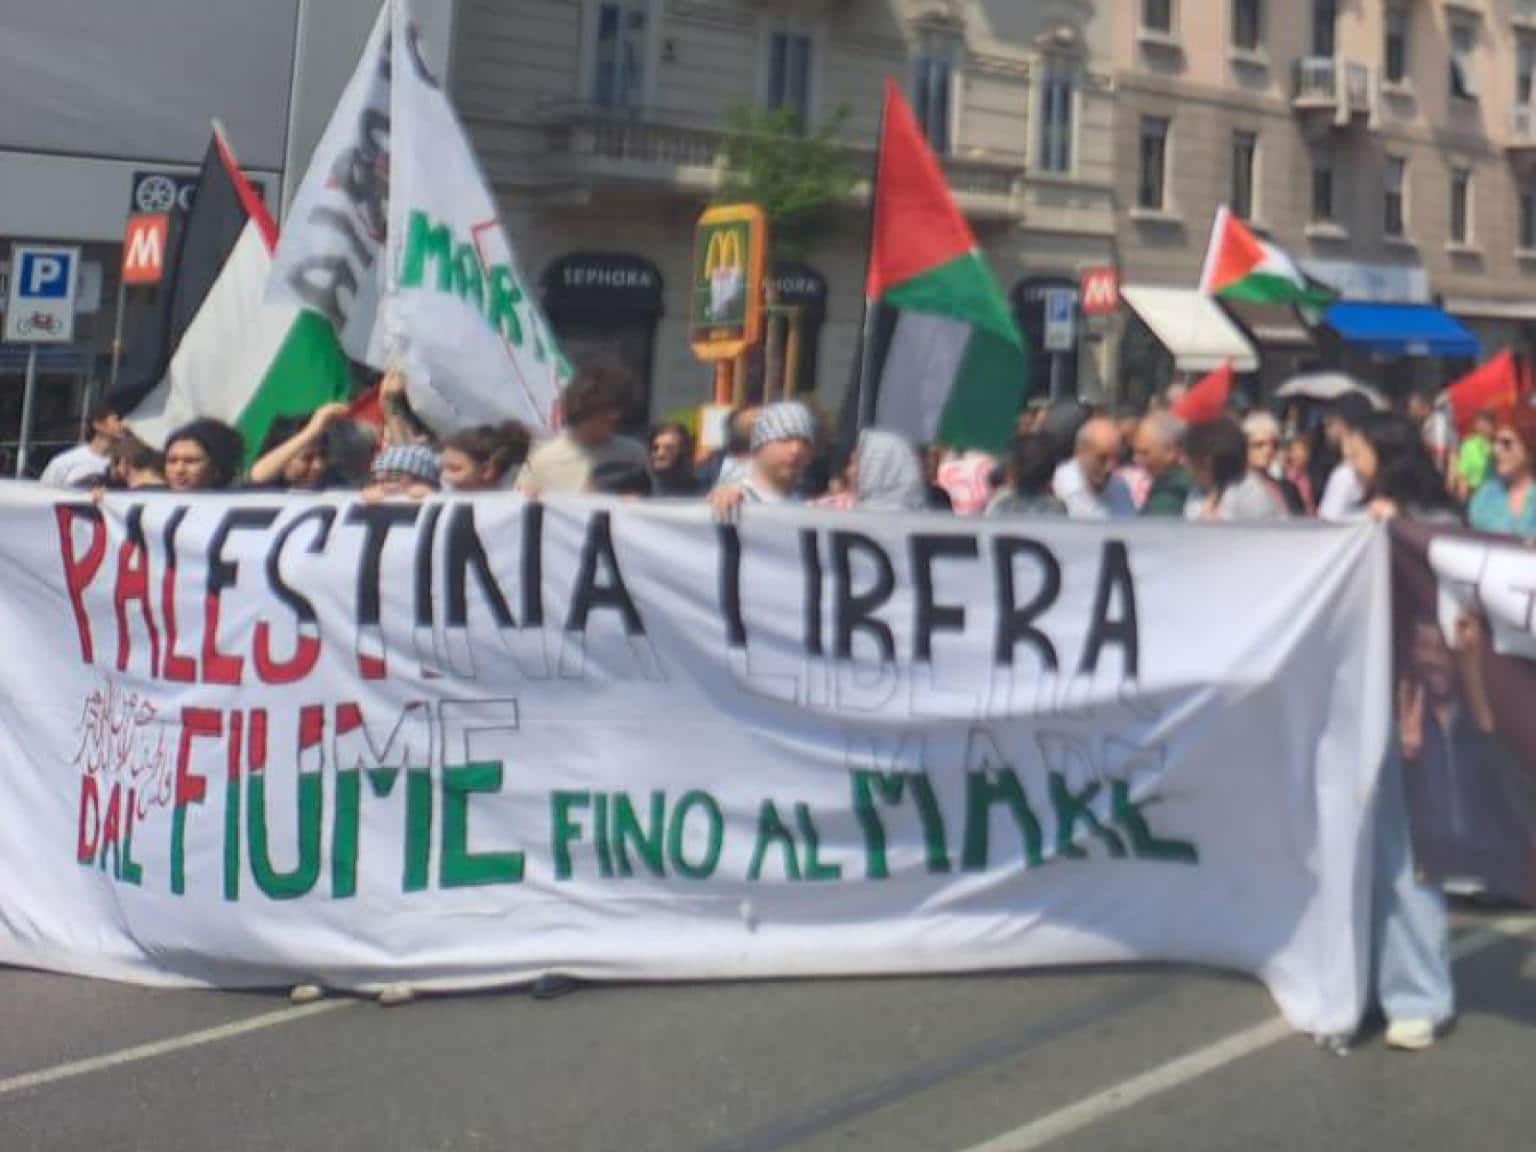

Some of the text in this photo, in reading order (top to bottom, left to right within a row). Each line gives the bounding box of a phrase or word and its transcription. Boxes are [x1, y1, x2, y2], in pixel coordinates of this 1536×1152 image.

[30, 257, 62, 293] P
[125, 226, 163, 268] M
[54, 503, 1152, 710] PALESTINA LIBERA
[77, 773, 143, 886] DAL
[170, 698, 525, 901] FIUME
[549, 789, 724, 882] FINO
[747, 798, 842, 881] AL
[847, 726, 1199, 880] MARE
